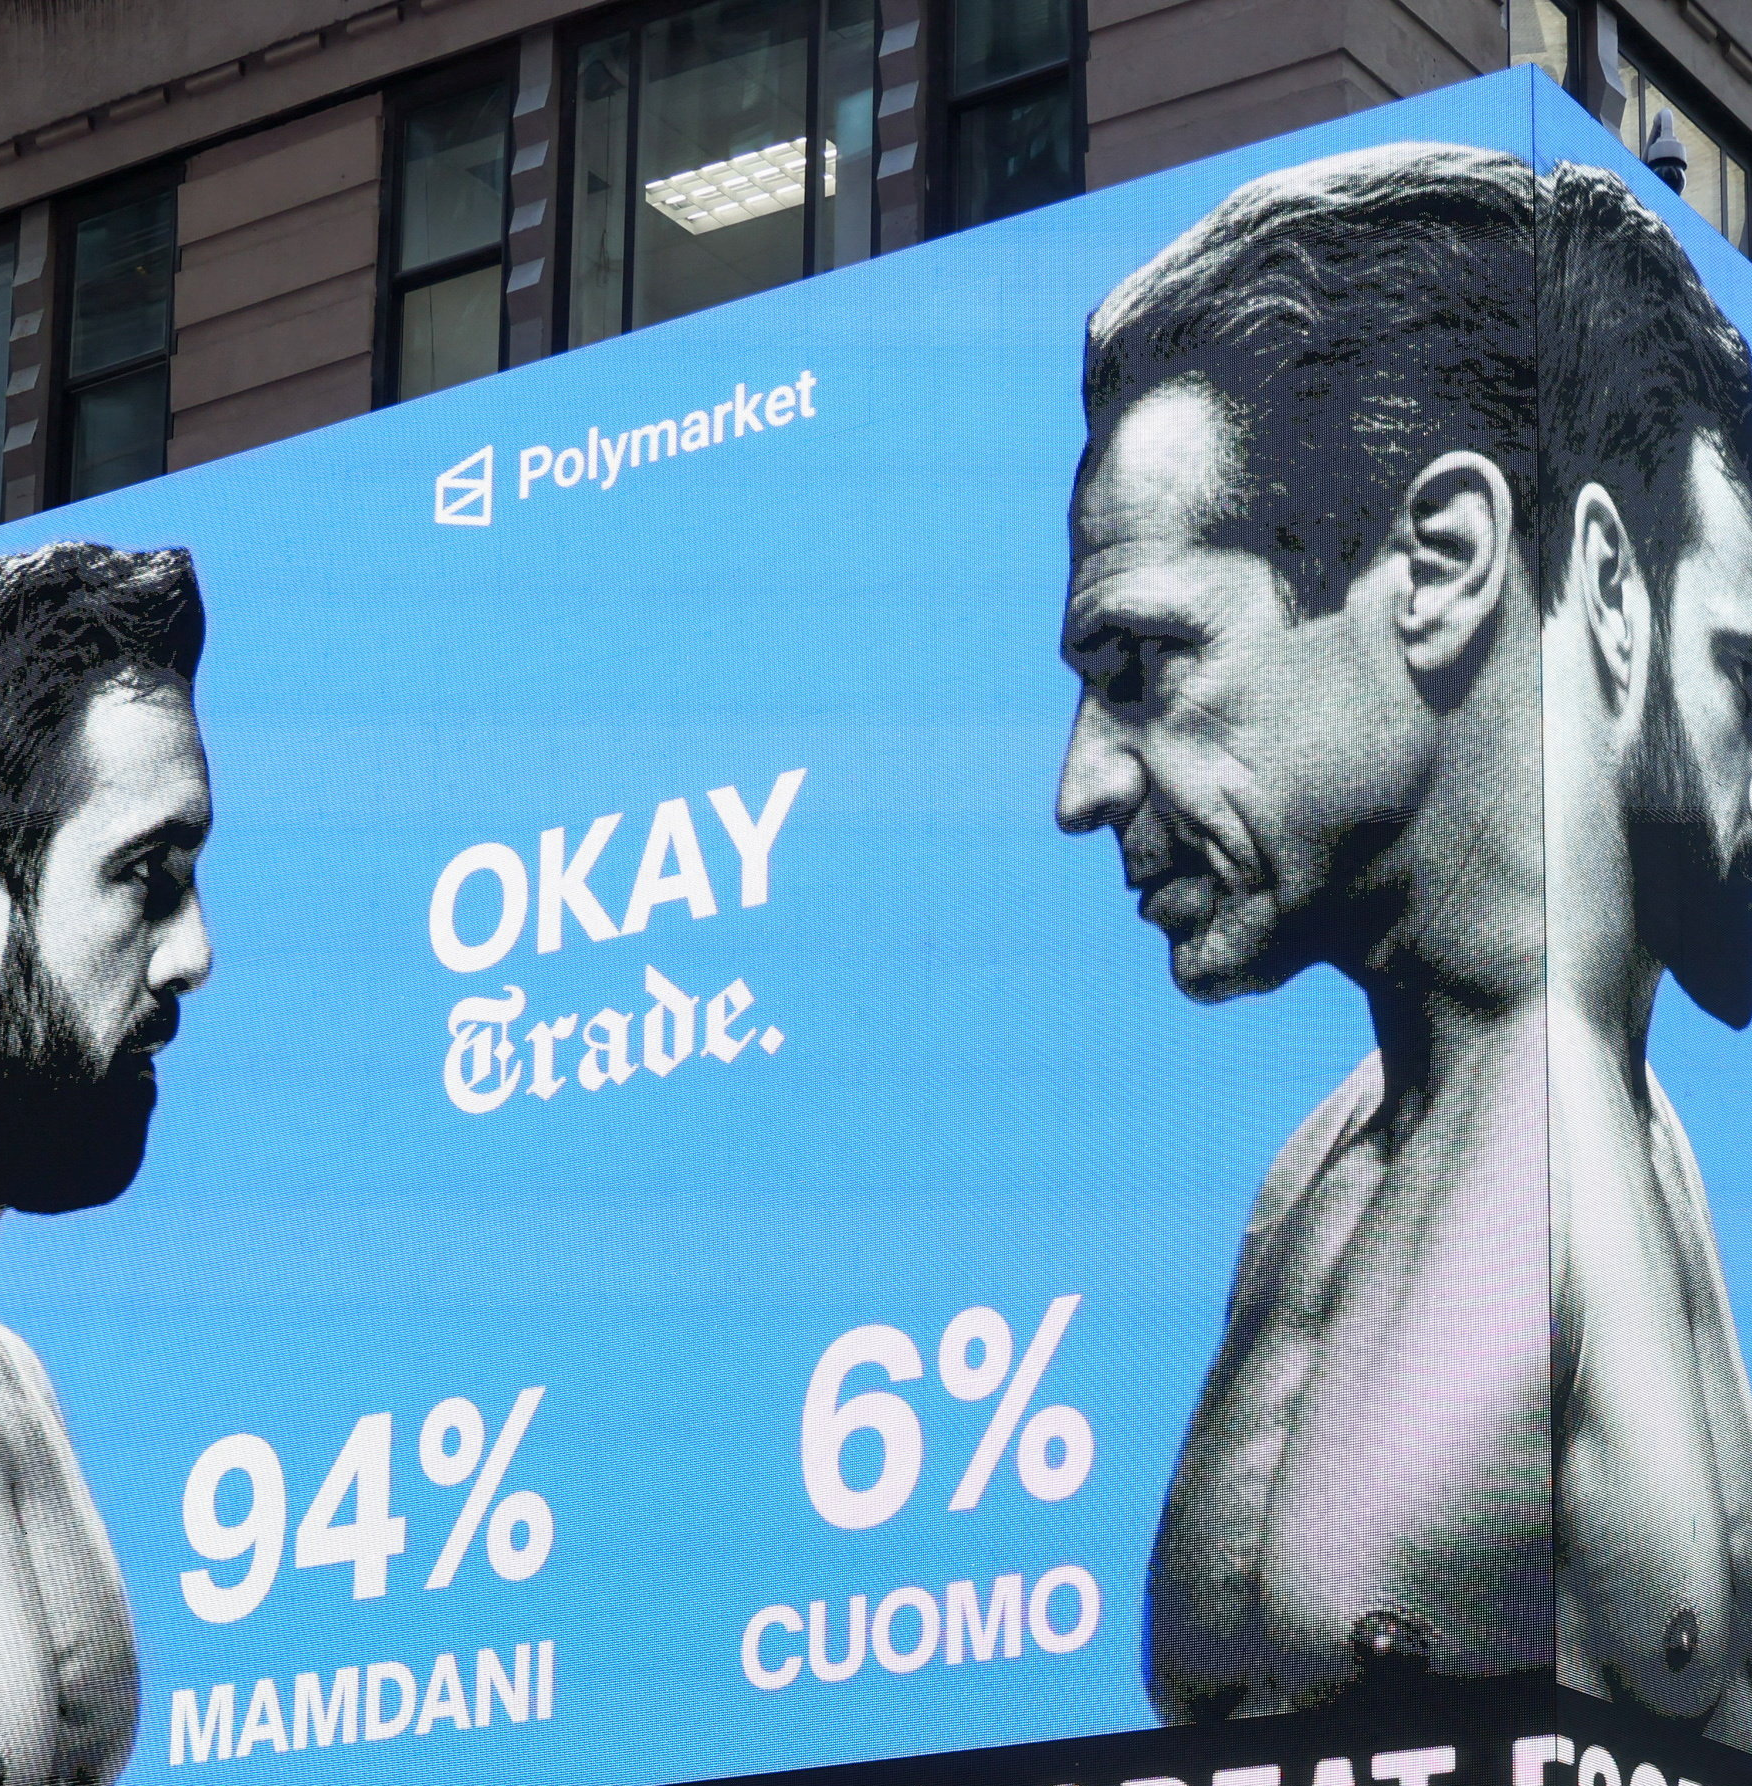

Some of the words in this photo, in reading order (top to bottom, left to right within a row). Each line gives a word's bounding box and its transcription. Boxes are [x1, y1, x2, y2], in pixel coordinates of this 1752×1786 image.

[518, 370, 817, 499] Polymarket
[429, 767, 808, 973] OKAY
[443, 963, 785, 1115] Trade.
[179, 1385, 555, 1624] 94%
[799, 1293, 1095, 1531] 6%
[169, 1639, 556, 1768] MAMDANI
[740, 1564, 1101, 1691] CUOMO
